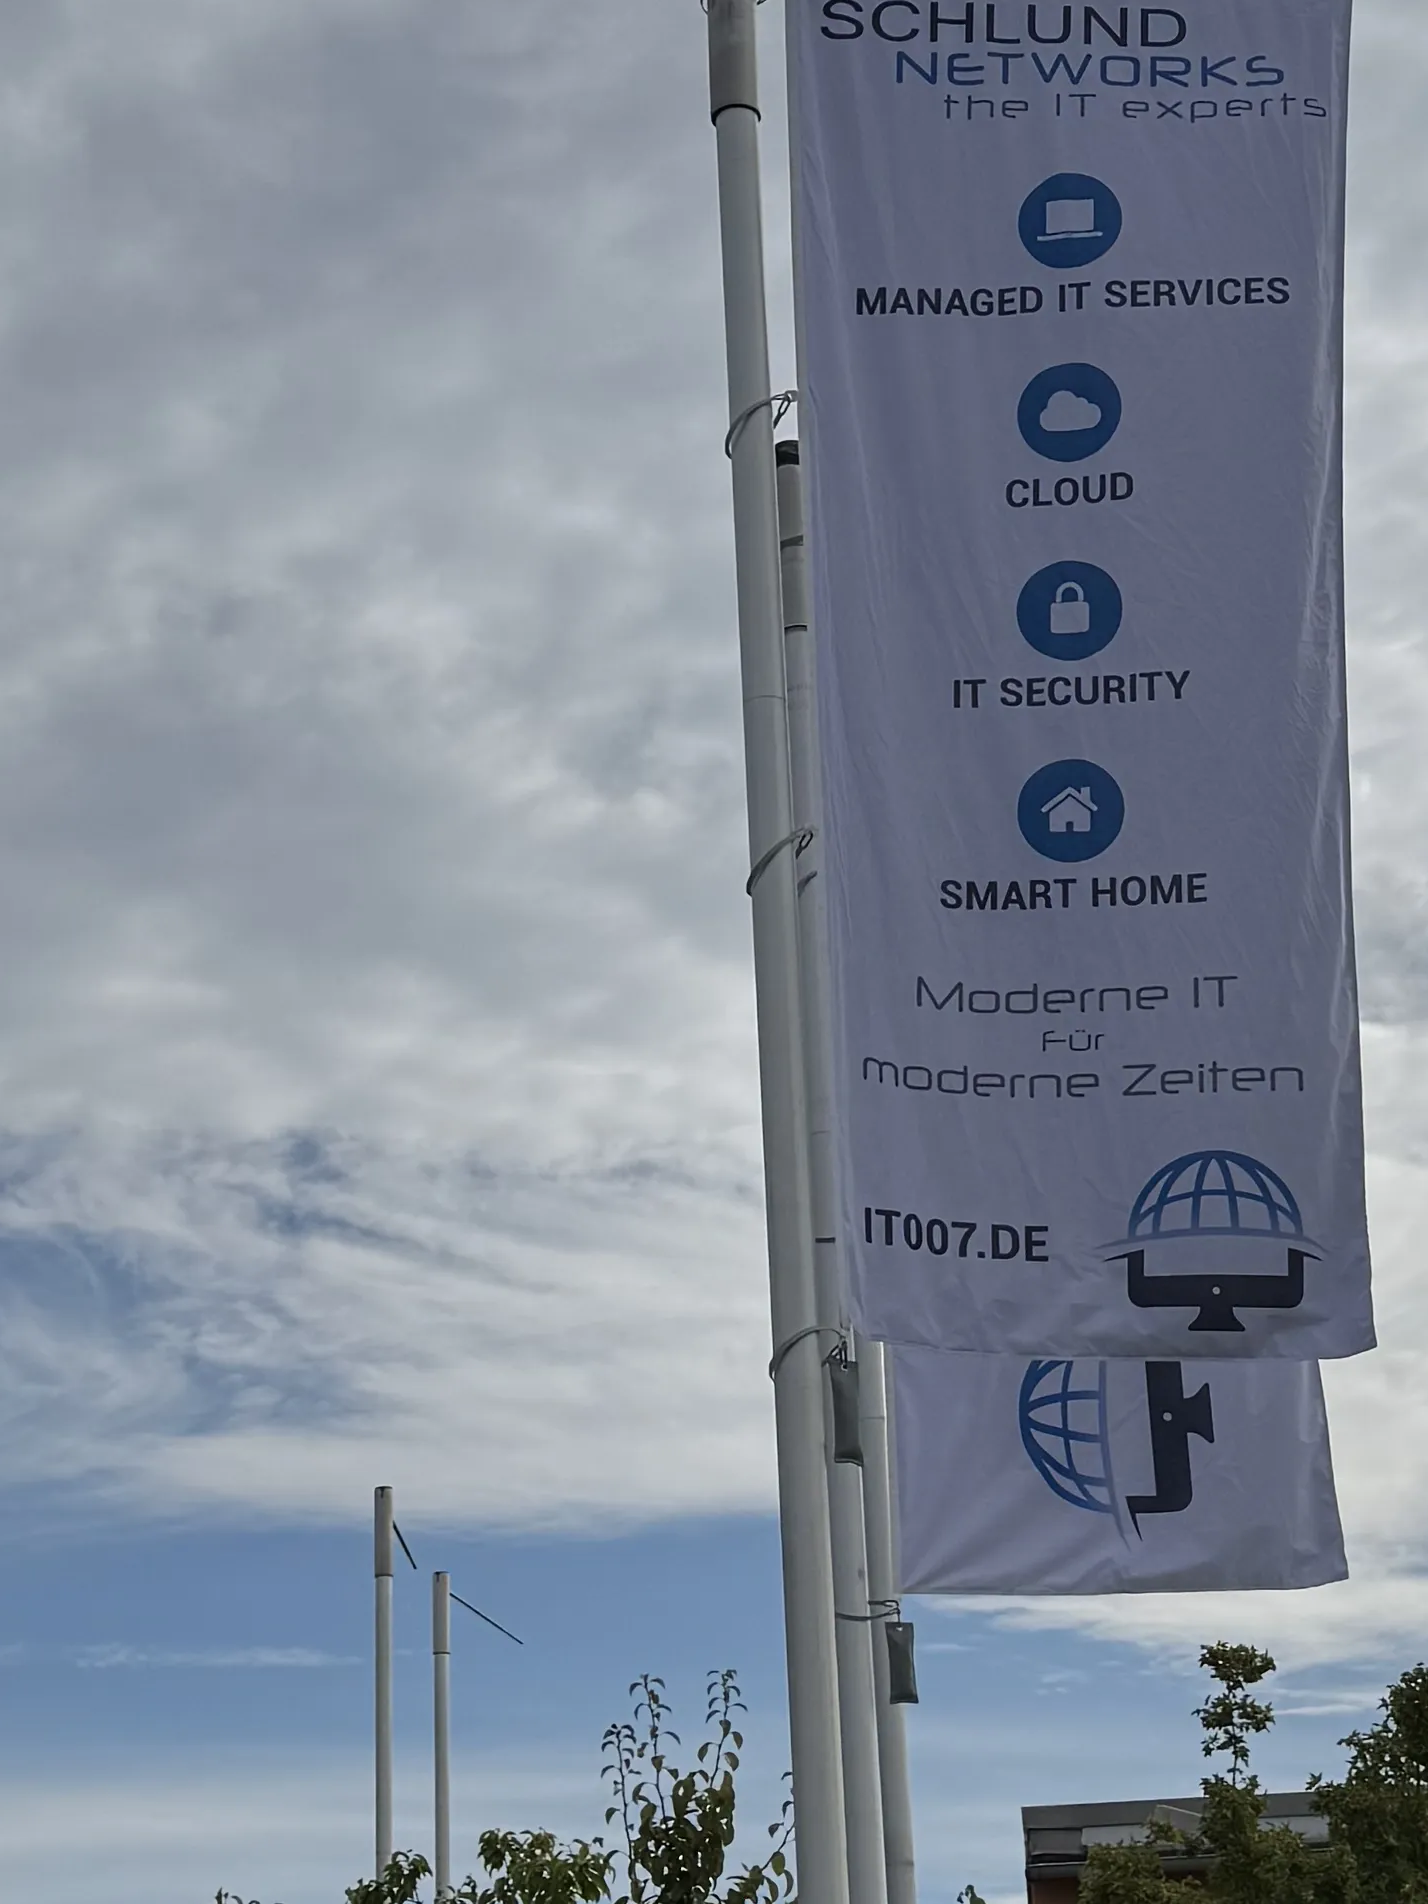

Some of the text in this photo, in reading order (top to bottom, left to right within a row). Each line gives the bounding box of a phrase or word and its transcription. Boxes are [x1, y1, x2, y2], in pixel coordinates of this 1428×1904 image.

[895, 51, 1285, 87] NETWORKS
[944, 92, 1327, 124] the IT experts
[856, 277, 1291, 317] MANAGED IT SERVICES
[1005, 471, 1135, 508] CLOUD
[952, 671, 1190, 709] IT SECURITY
[939, 873, 1208, 911] SMART HOME
[916, 975, 1239, 1014] Moderne IT
[862, 1056, 1304, 1098] moderne Zeiten
[864, 1206, 1049, 1262] IT007.DE
